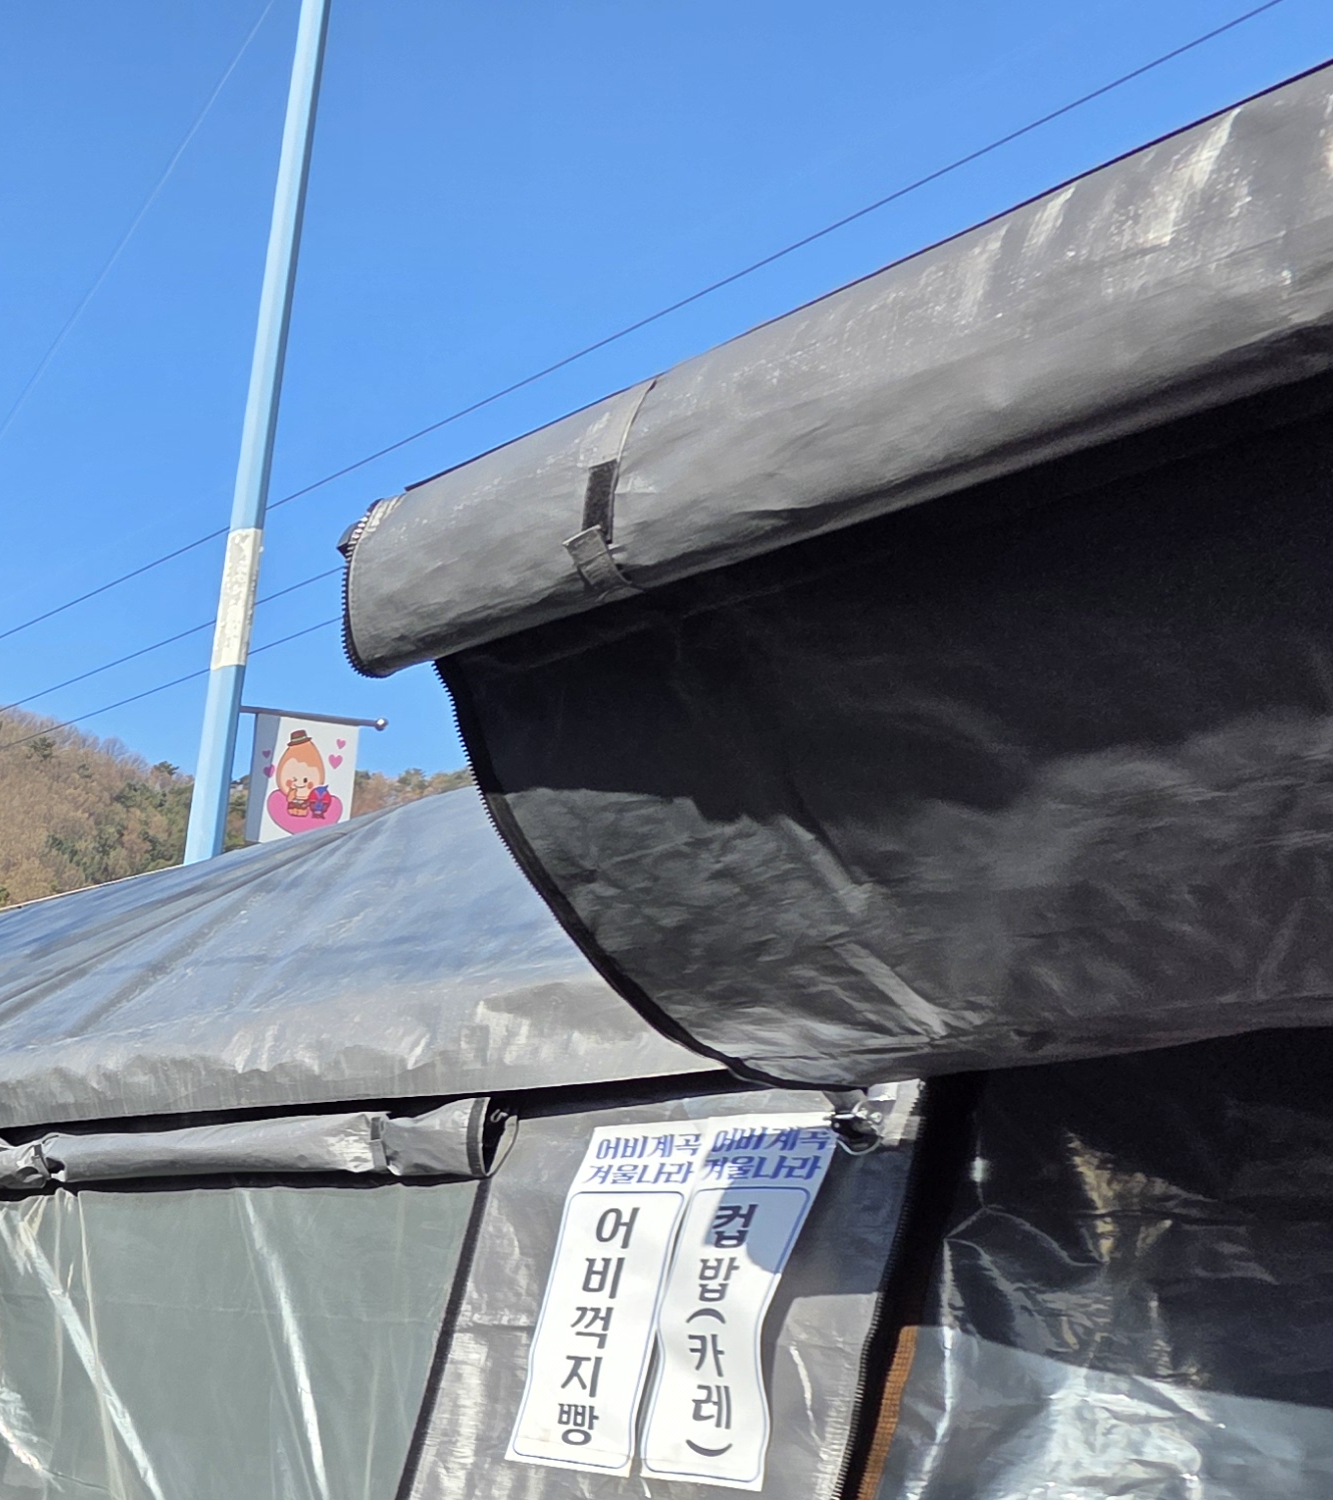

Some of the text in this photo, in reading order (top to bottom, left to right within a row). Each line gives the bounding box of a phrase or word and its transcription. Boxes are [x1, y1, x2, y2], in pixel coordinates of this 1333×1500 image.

[595, 1134, 702, 1160] 어비계곡
[712, 1126, 835, 1153] 어비계곡
[583, 1162, 694, 1186] 겨울나라
[703, 1156, 821, 1181] 겨울나라
[556, 1207, 640, 1446] 어비꺽지빵
[685, 1203, 758, 1457] 컵밥(카레)
